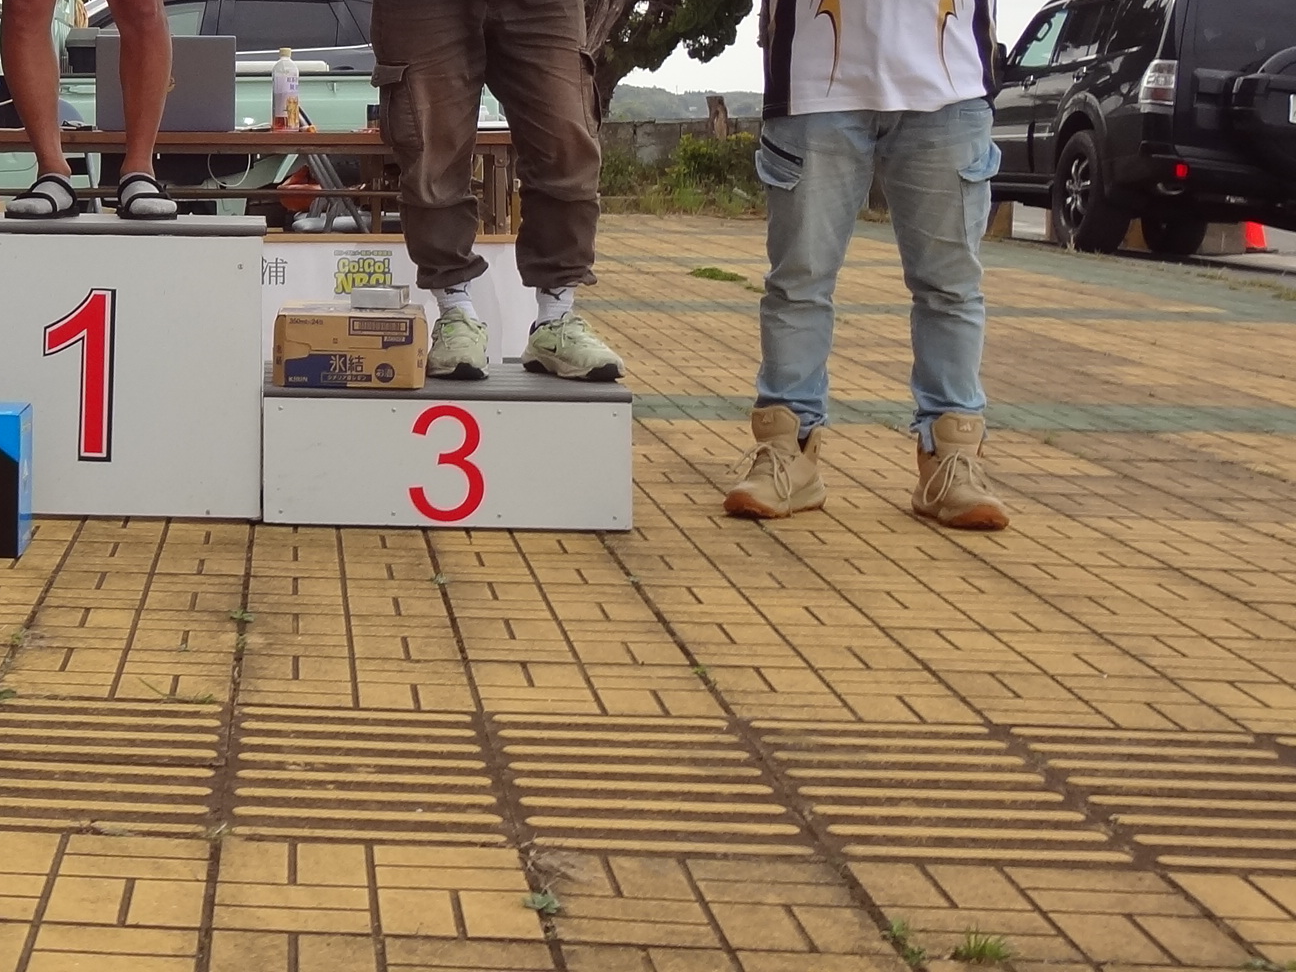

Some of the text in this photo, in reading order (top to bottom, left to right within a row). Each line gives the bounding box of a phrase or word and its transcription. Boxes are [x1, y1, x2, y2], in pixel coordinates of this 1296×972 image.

[43, 288, 117, 463] 1
[328, 354, 366, 373] 氷結
[408, 404, 485, 523] 3
